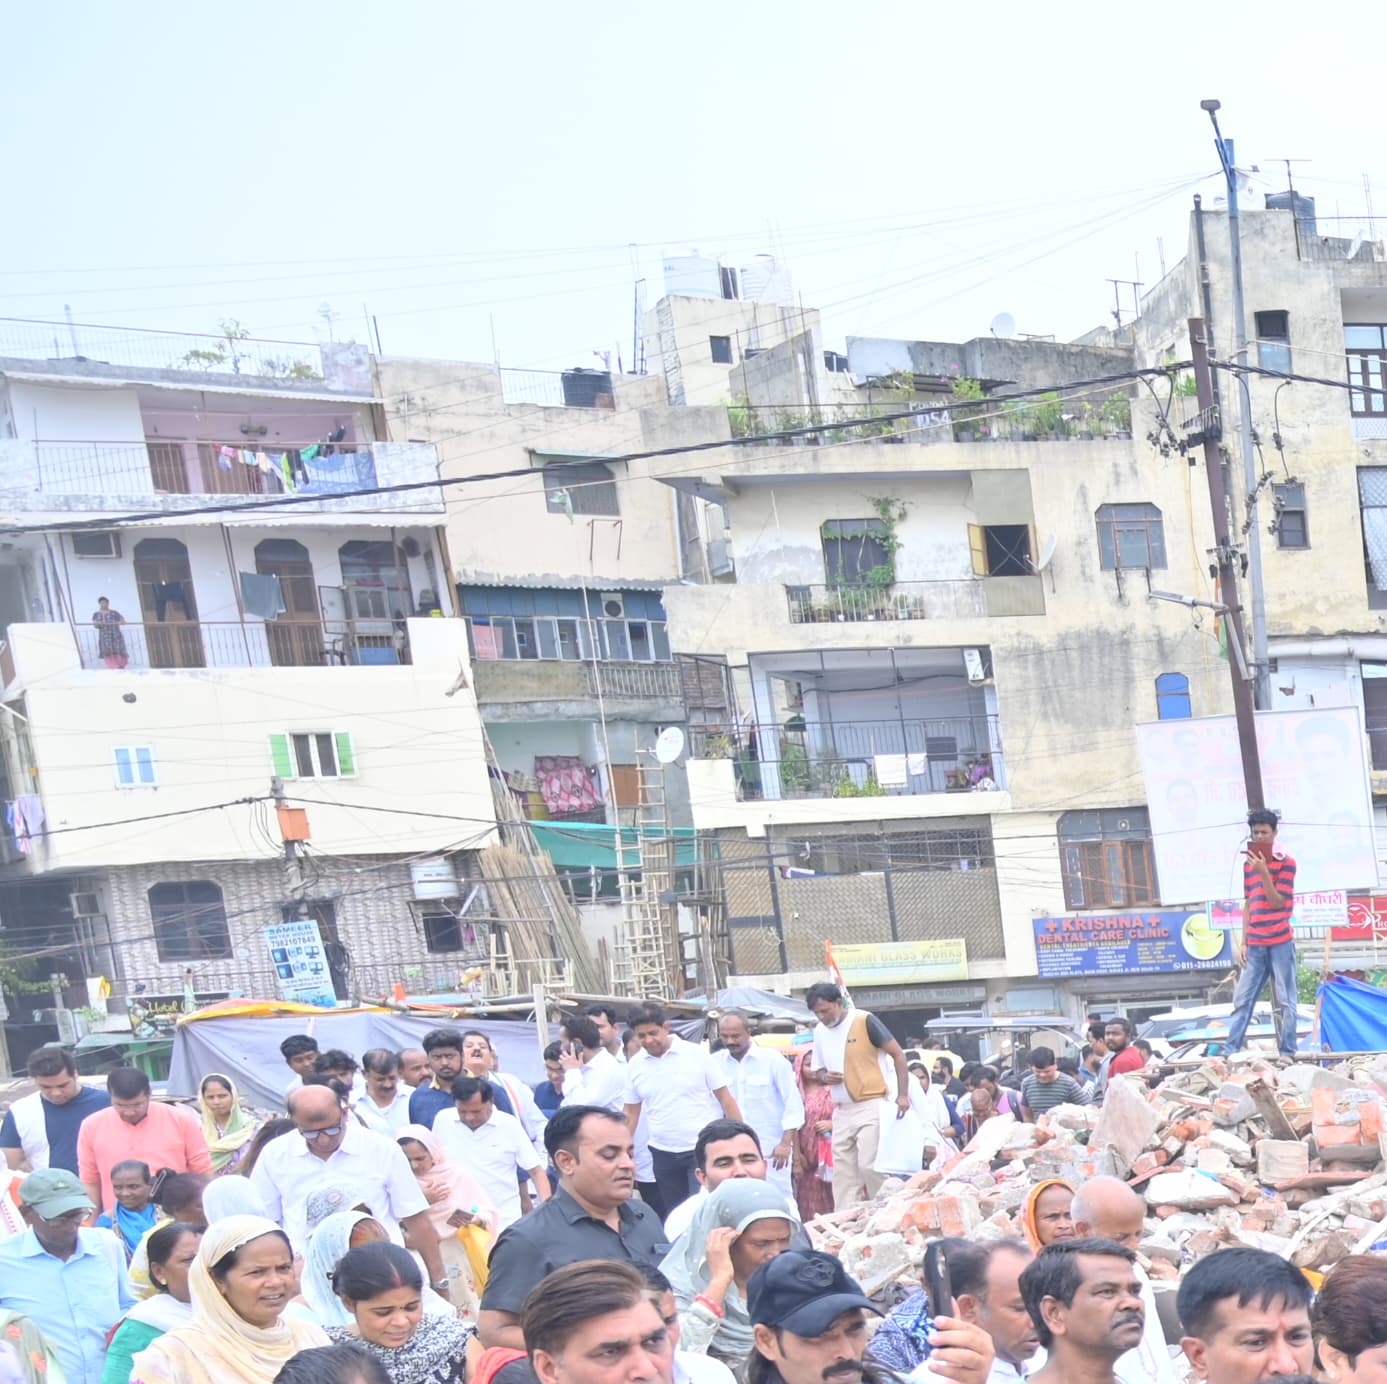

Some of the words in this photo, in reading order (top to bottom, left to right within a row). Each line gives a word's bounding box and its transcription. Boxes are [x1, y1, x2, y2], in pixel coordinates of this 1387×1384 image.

[1062, 915, 1145, 931] KRISHNA
[1038, 932, 1087, 944] DENTAL
[1091, 930, 1123, 941] CARE
[1129, 927, 1170, 939] CLINIC
[148, 1000, 178, 1014] Hotel
